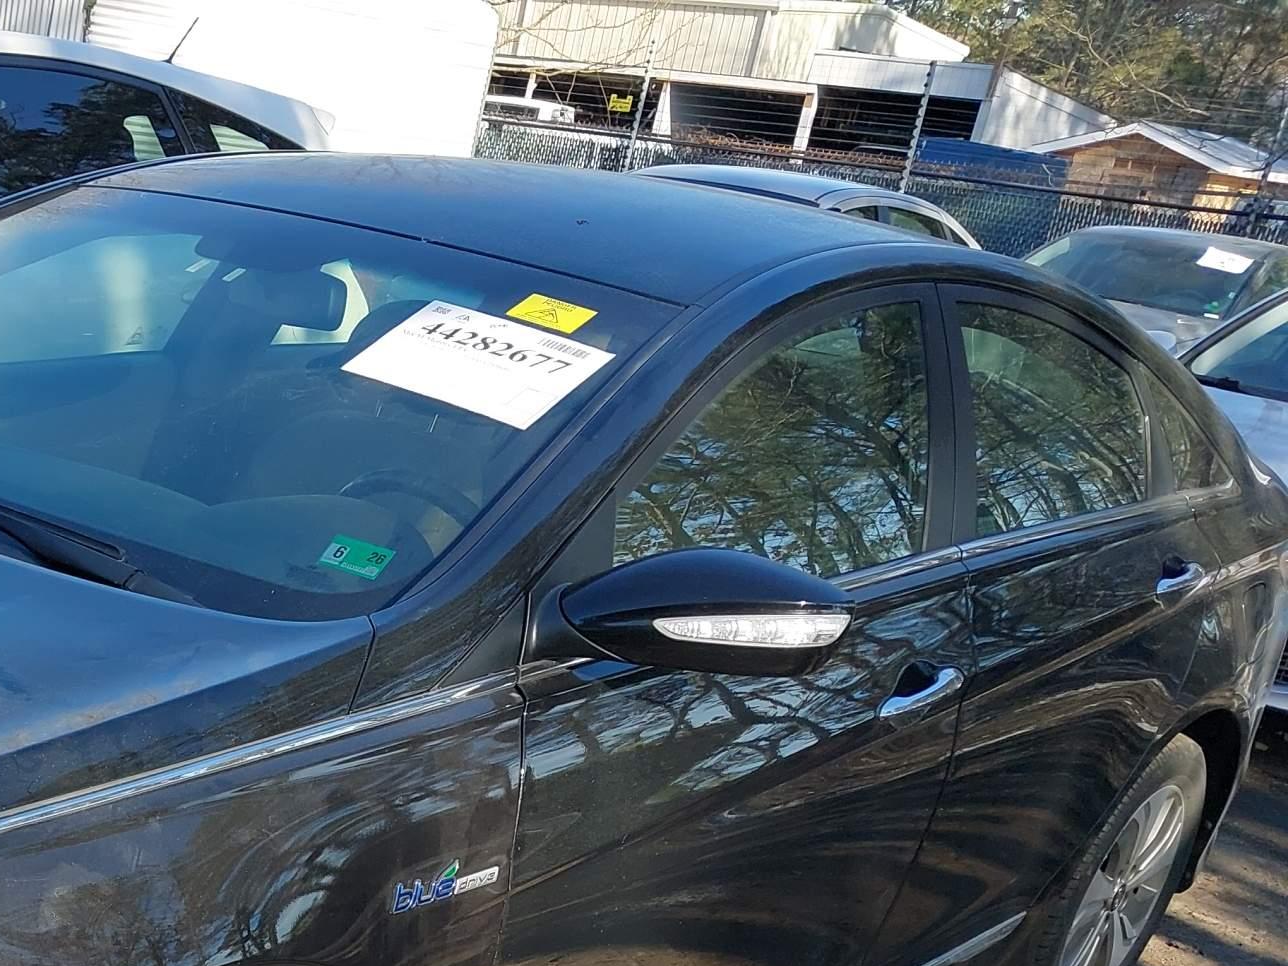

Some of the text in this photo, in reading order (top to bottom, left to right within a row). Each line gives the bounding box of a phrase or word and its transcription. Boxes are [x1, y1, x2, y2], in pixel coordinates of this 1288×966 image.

[421, 322, 573, 374] 44282677
[333, 545, 347, 559] 6
[367, 551, 387, 565] 26
[390, 870, 496, 914] blue drive
